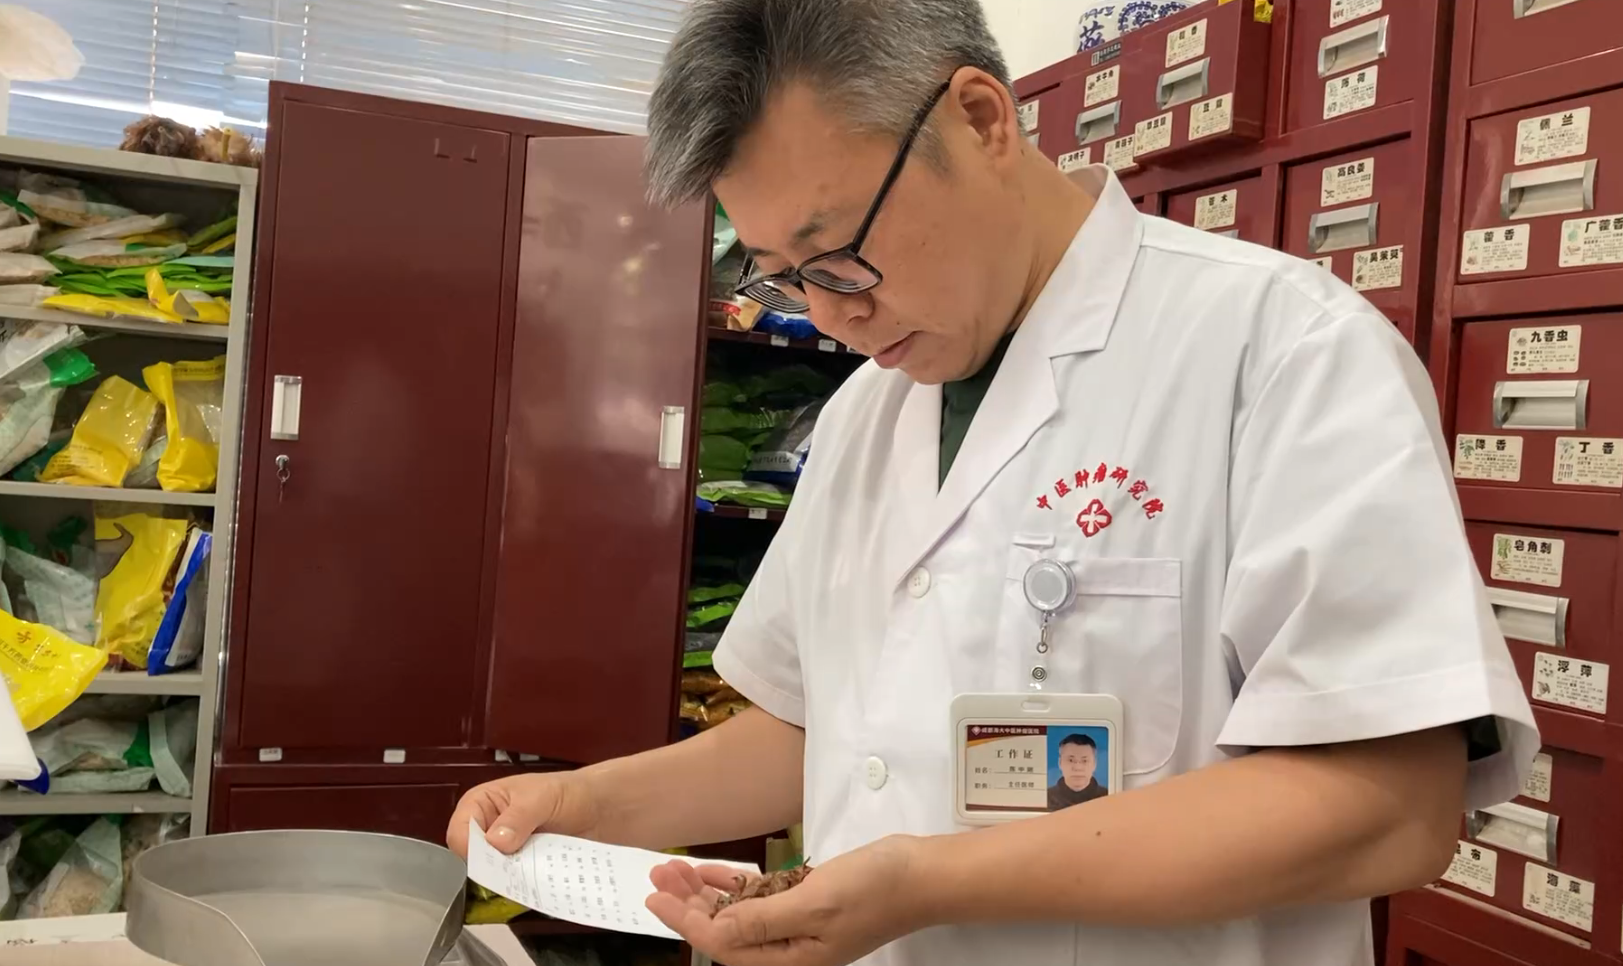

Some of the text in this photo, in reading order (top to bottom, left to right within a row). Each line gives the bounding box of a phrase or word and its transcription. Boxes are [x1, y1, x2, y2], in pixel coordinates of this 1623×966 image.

[1340, 72, 1366, 89] 薄荷
[1539, 113, 1574, 131] 佩兰
[1337, 162, 1366, 178] 高良姜
[1584, 217, 1623, 234] 广藿香
[1369, 249, 1399, 263] 吴茱萸
[1530, 329, 1569, 343] 九香虫
[1475, 438, 1506, 451] 降香
[1578, 441, 1615, 455] 丁香
[1036, 462, 1164, 520] 中医肿瘤研究院
[1513, 539, 1552, 555] 皂角刺
[1557, 660, 1593, 678] 浮萍
[995, 749, 1033, 759] 工作证
